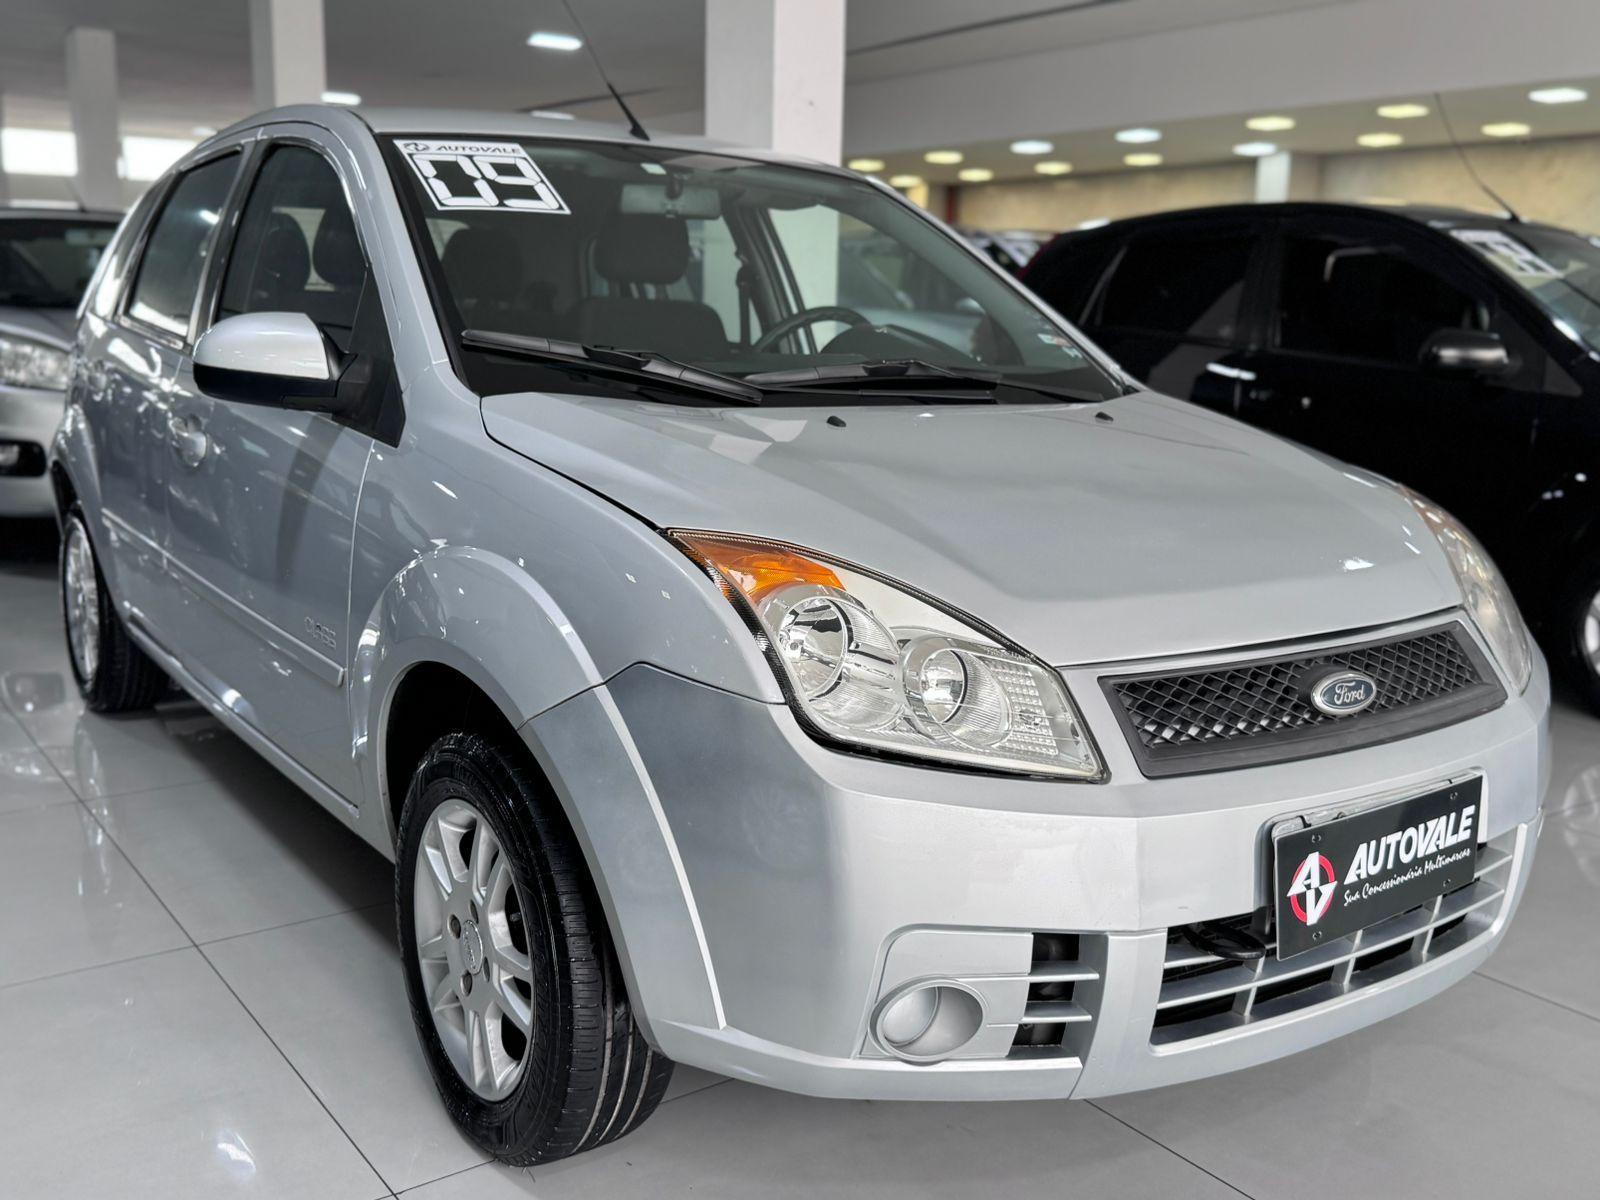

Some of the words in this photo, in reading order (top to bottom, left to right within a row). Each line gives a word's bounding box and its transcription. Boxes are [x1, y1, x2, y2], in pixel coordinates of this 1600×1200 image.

[437, 145, 521, 154] AUTOVALE
[412, 154, 560, 210] 09
[1333, 681, 1366, 705] Ford
[1343, 804, 1476, 885] AUTOVALE
[1343, 889, 1360, 907] Sua
[1424, 847, 1471, 875] Multimarcas
